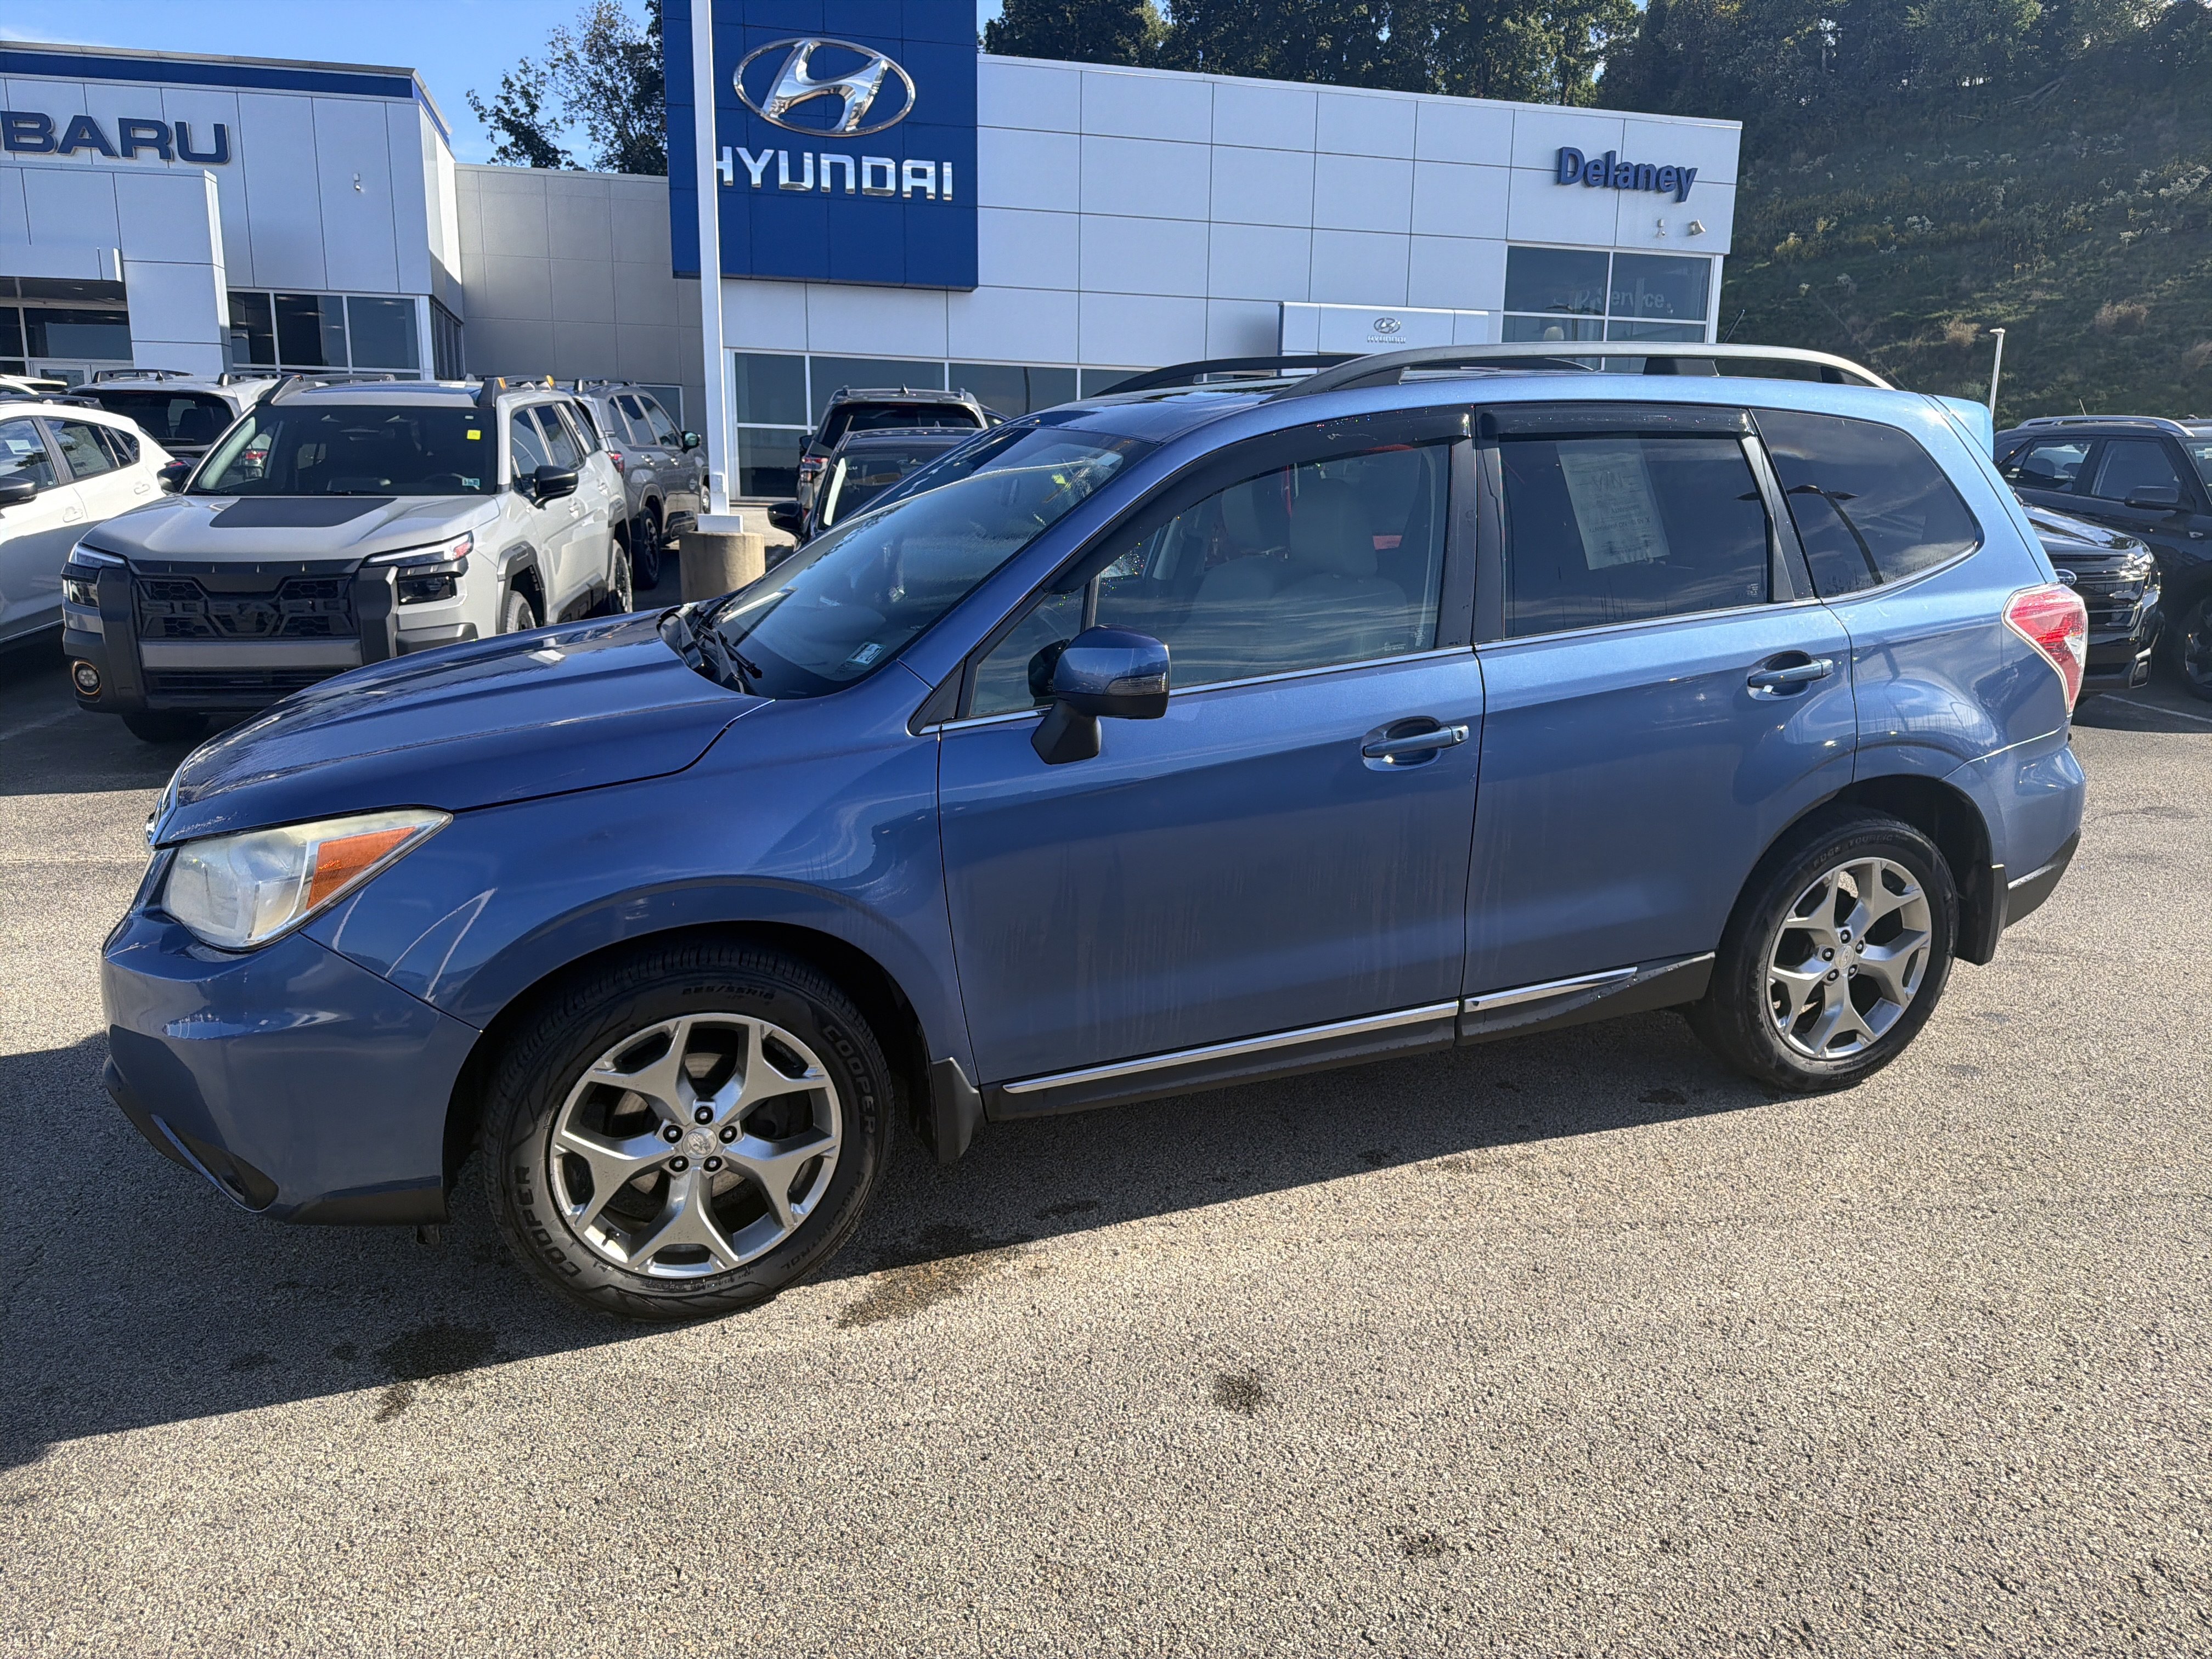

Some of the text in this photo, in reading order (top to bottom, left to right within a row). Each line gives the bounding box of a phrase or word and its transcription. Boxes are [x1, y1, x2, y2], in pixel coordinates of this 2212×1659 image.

[716, 146, 952, 201] HYUNDAI
[1558, 146, 1699, 202] Delaney
[1367, 335, 1406, 343] HYUNDAI
[822, 1024, 876, 1134] COOPER
[514, 1164, 582, 1277] COOPER
